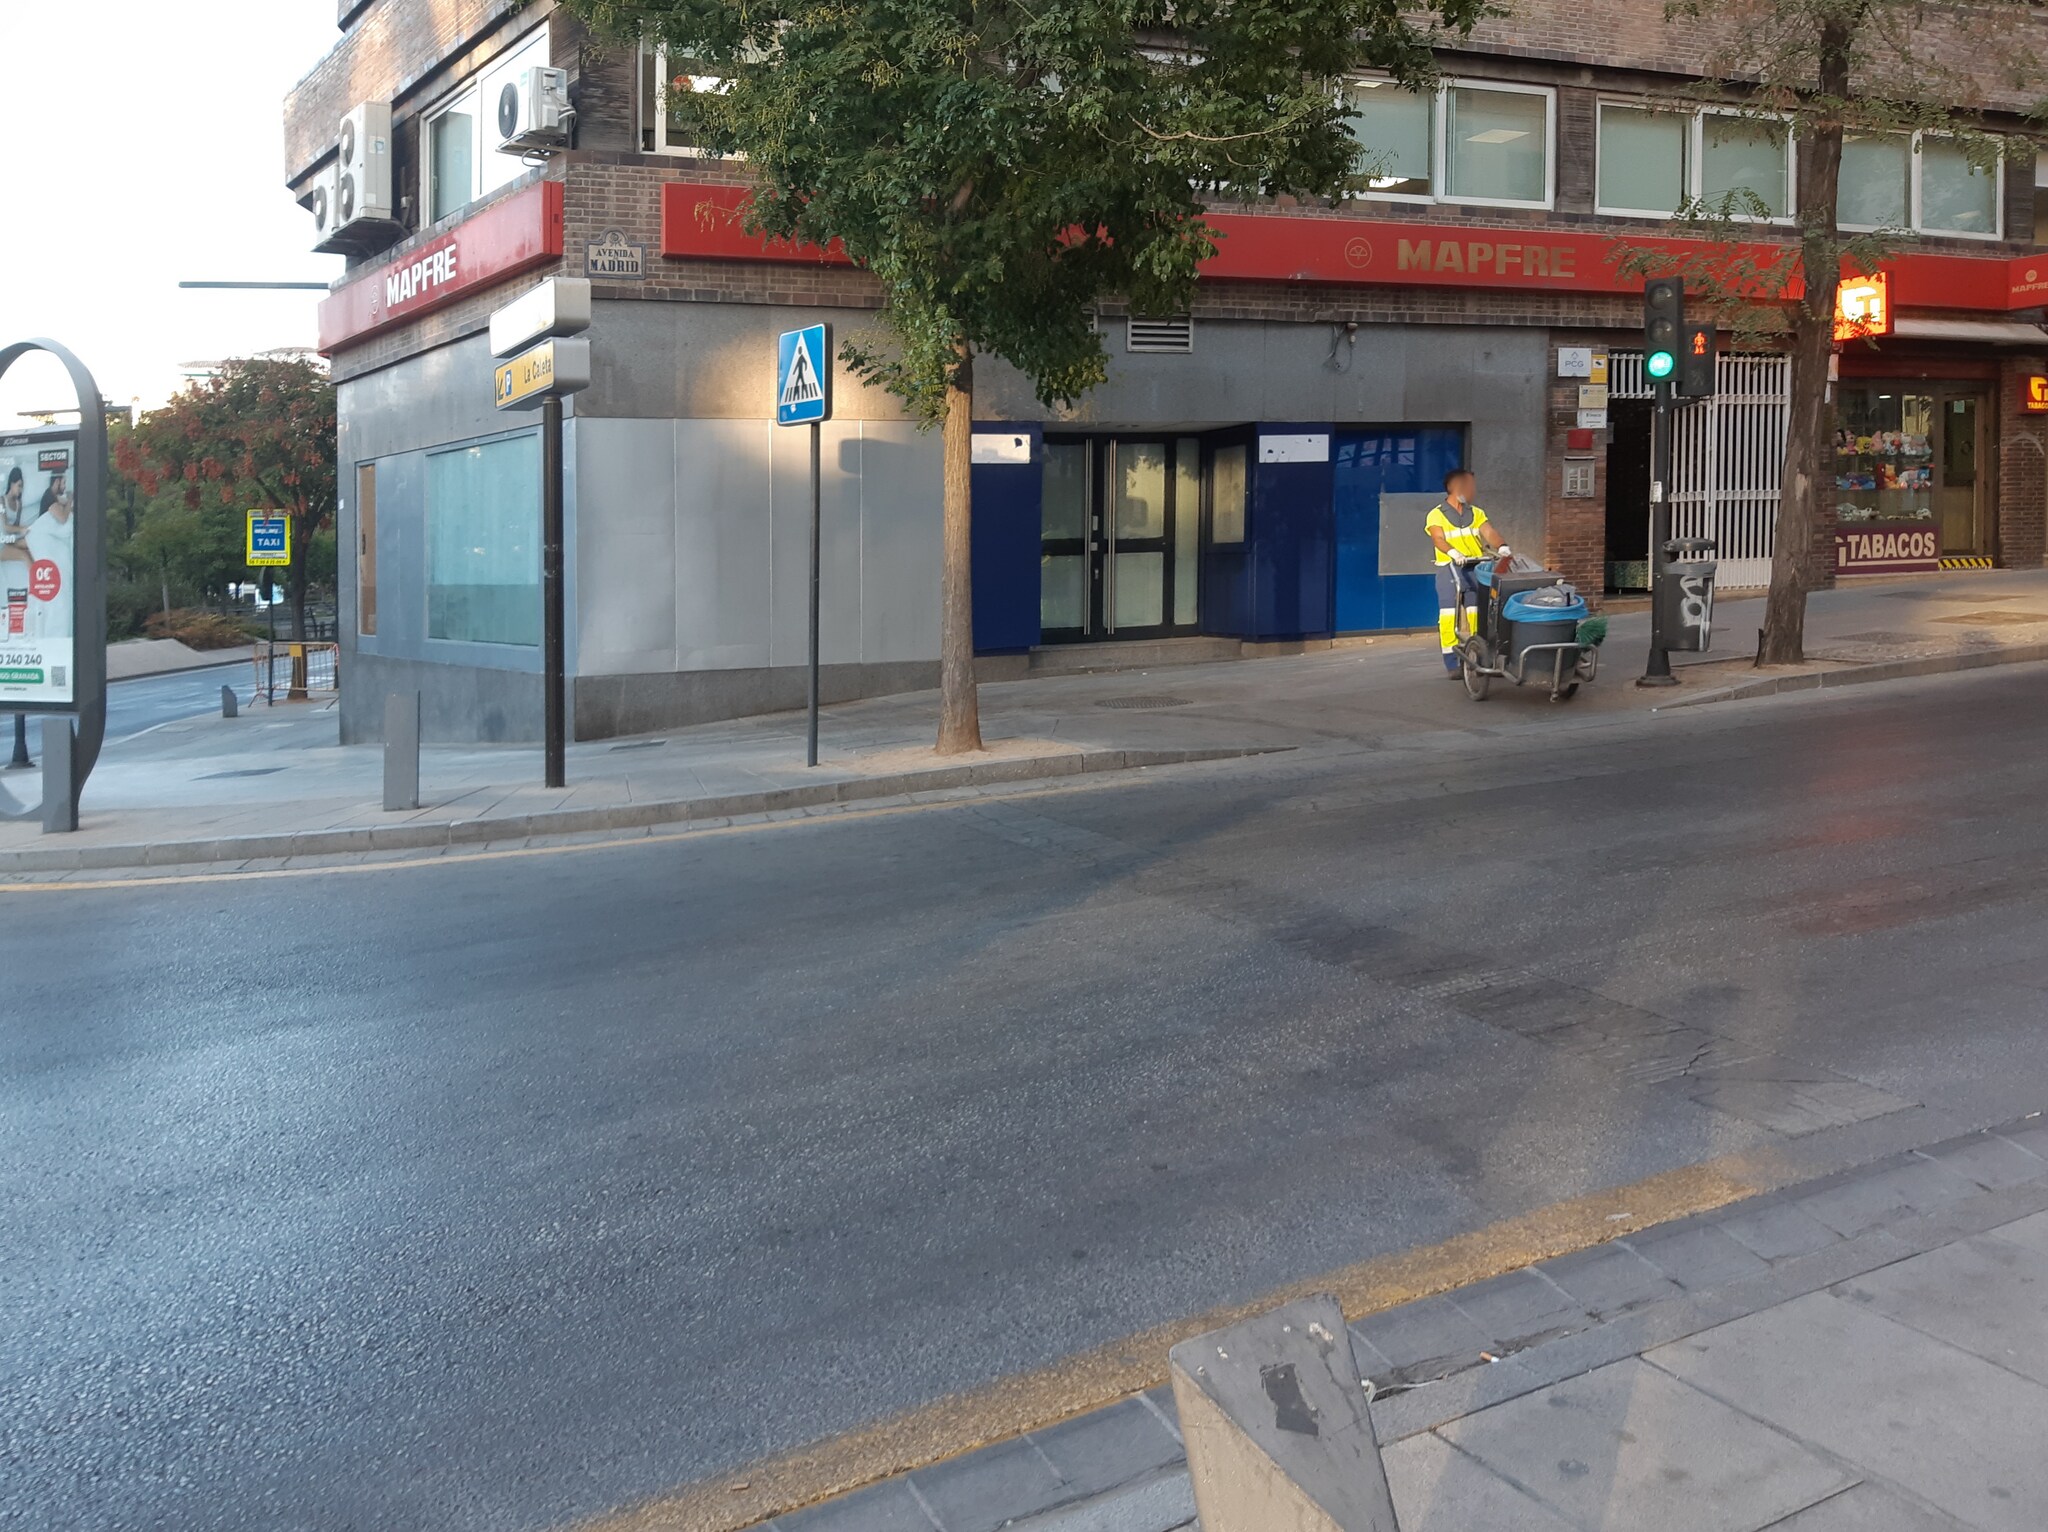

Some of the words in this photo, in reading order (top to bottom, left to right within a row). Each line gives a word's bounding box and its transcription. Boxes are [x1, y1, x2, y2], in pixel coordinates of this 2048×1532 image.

[596, 249, 634, 258] AVENIDA
[1396, 239, 1576, 277] MAPFRE
[590, 259, 638, 272] MADRID
[386, 243, 457, 308] MAPFRE
[524, 366, 531, 384] La
[532, 355, 552, 380] Caleta
[39, 451, 67, 462] SECTOR
[257, 538, 280, 546] TAXI
[1847, 532, 1935, 559] TABACOS
[6, 654, 22, 665] 240
[25, 654, 42, 665] 240
